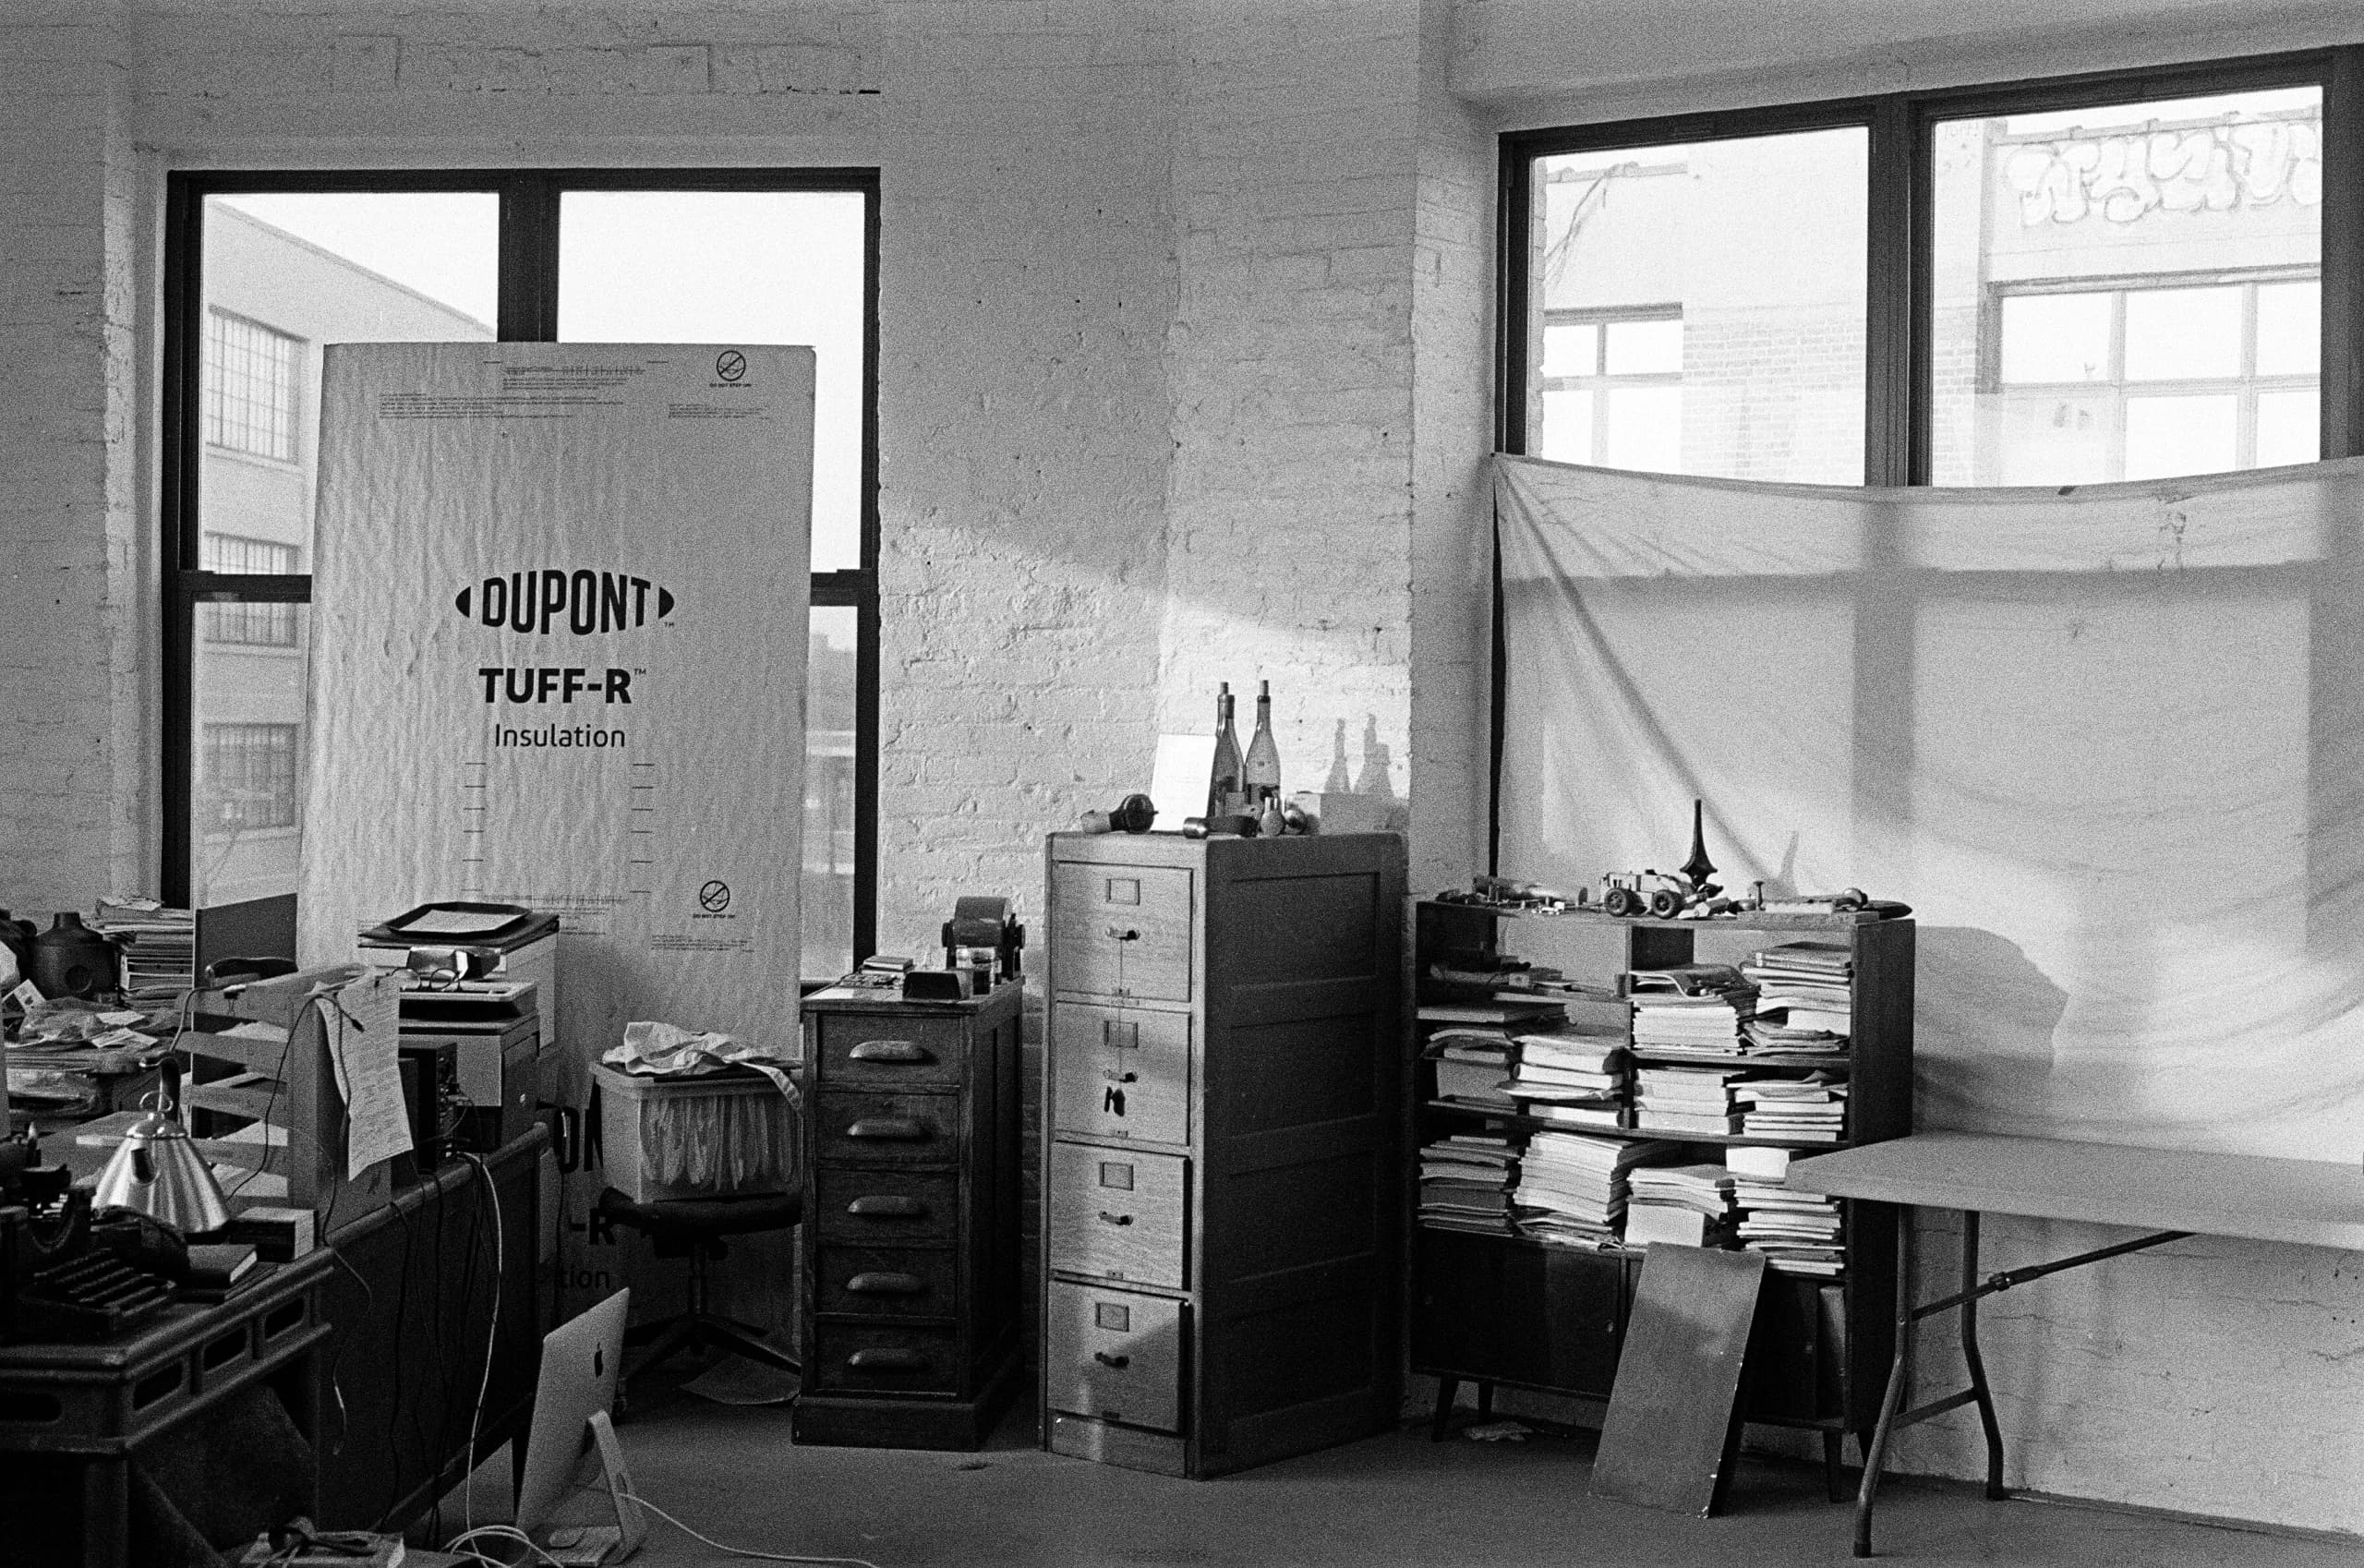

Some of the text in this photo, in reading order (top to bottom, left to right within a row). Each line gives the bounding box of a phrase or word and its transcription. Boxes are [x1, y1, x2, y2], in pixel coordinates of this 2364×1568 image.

[482, 569, 650, 634] DUPONT
[478, 668, 632, 704] TUFF-R
[495, 723, 625, 748] Insulation
